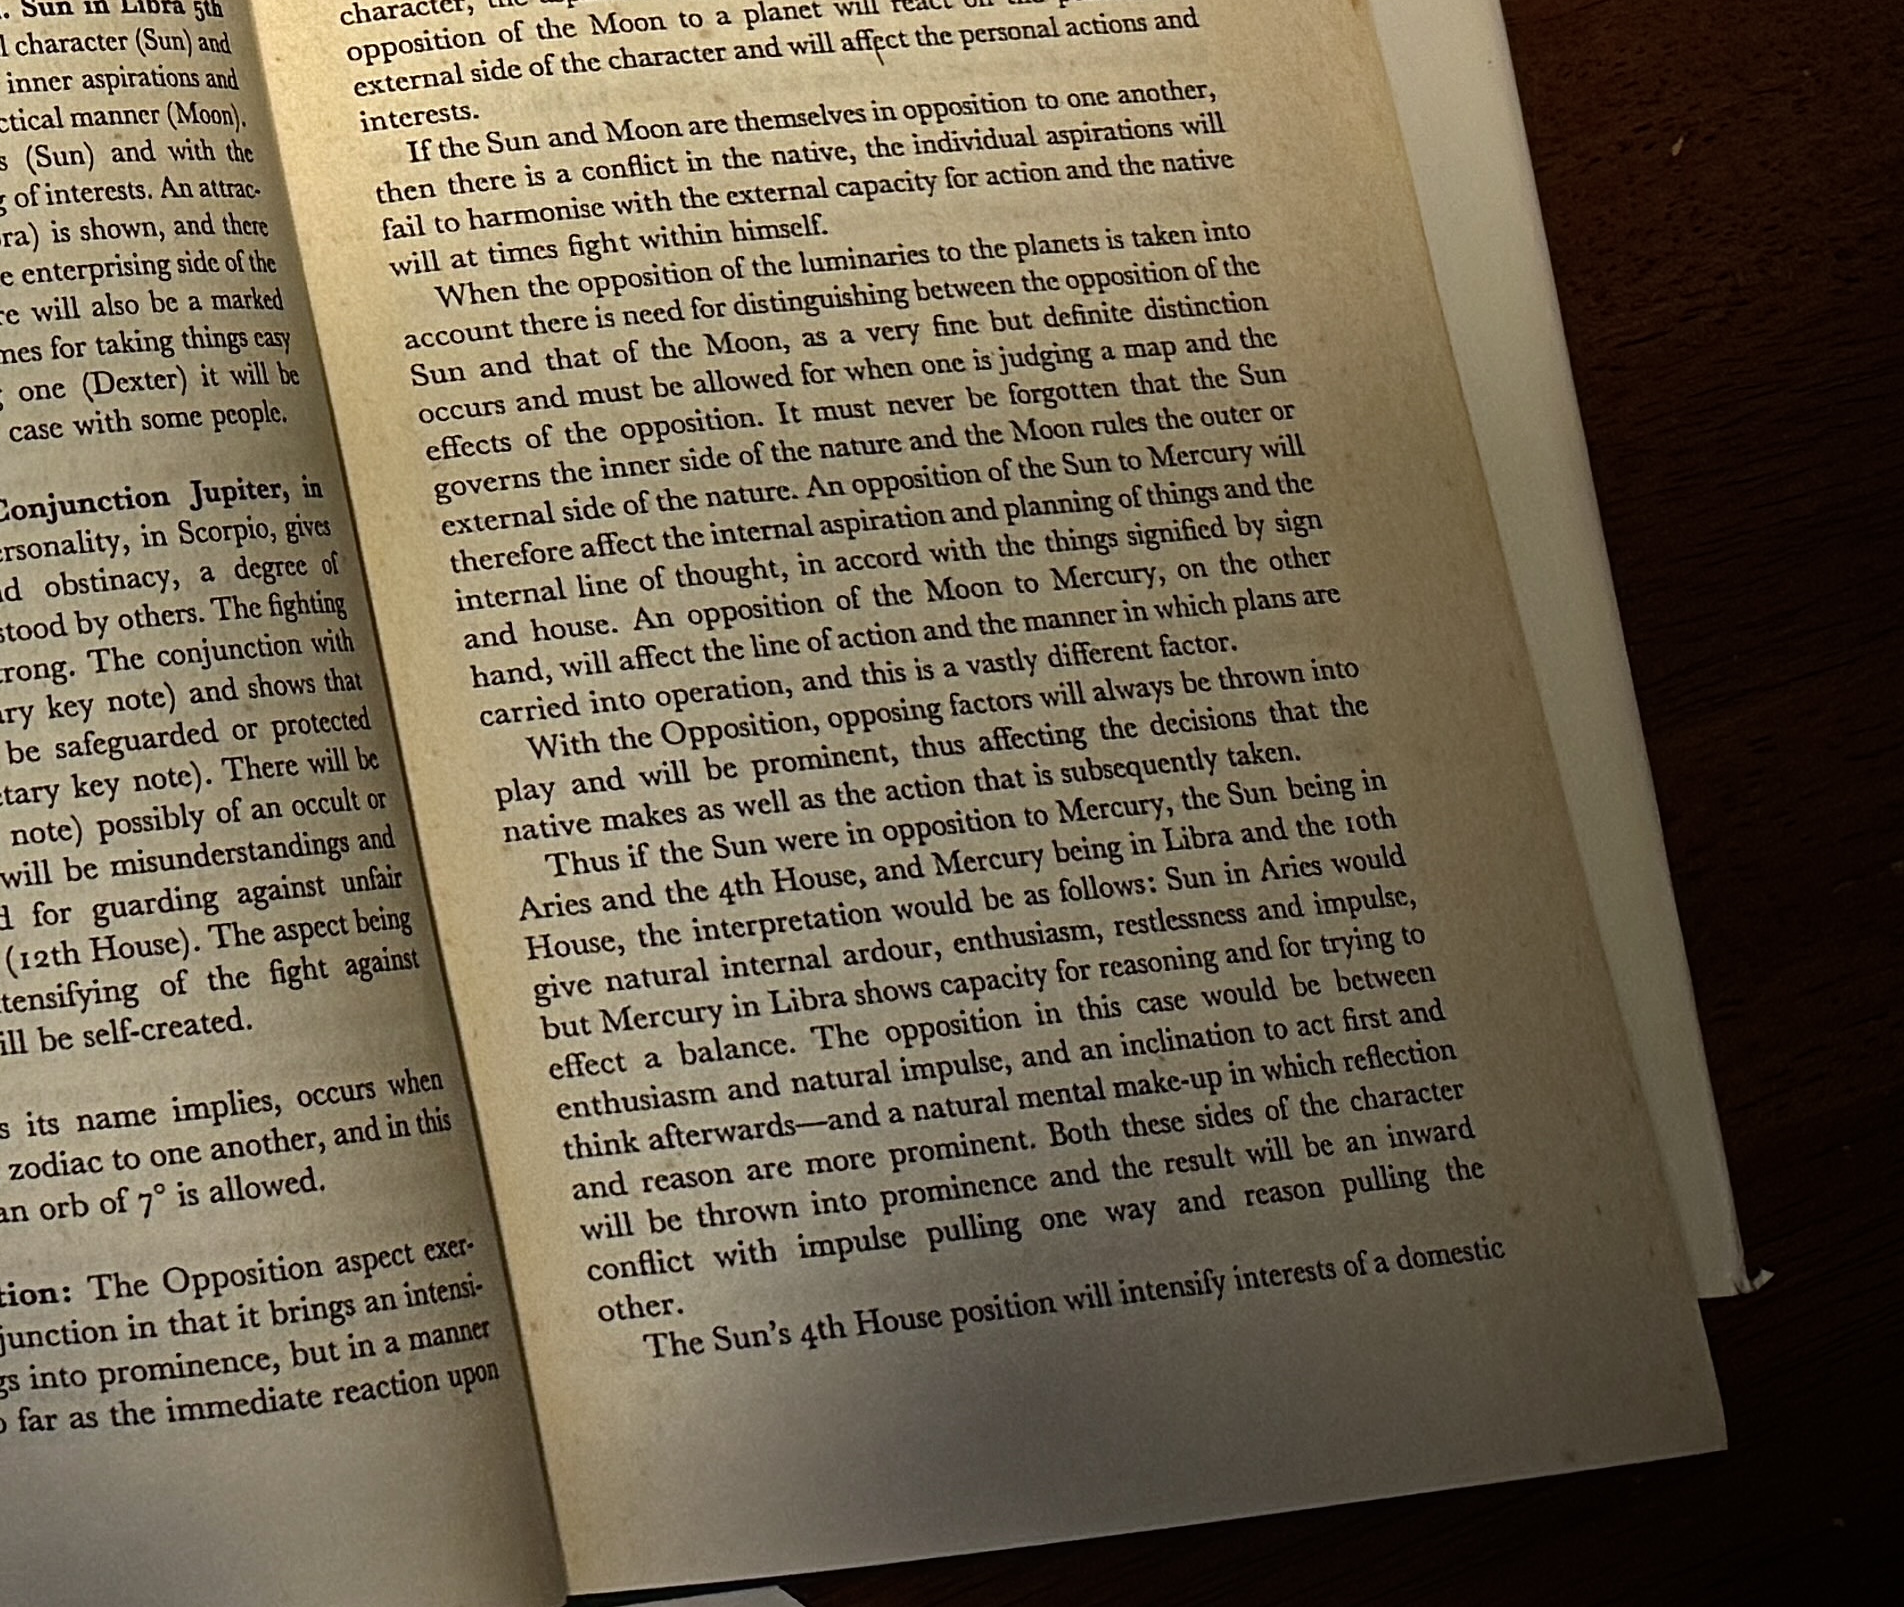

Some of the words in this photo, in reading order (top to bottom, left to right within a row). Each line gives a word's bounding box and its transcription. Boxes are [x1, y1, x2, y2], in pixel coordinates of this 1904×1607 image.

[83, 0, 111, 15] in
[359, 104, 479, 133] interests.
[597, 1293, 684, 1323] other.
[642, 1330, 705, 1359] The
[712, 1320, 792, 1352] Sun's
[800, 1313, 848, 1350] 4th
[852, 1307, 943, 1337] House
[950, 1292, 1057, 1334] position
[1063, 1281, 1113, 1311] will
[1118, 1268, 1226, 1305] intensify
[1233, 1260, 1337, 1291] interests
[1343, 1249, 1368, 1277] of
[1374, 1256, 1390, 1273] a
[1396, 1241, 1506, 1271] domestic
